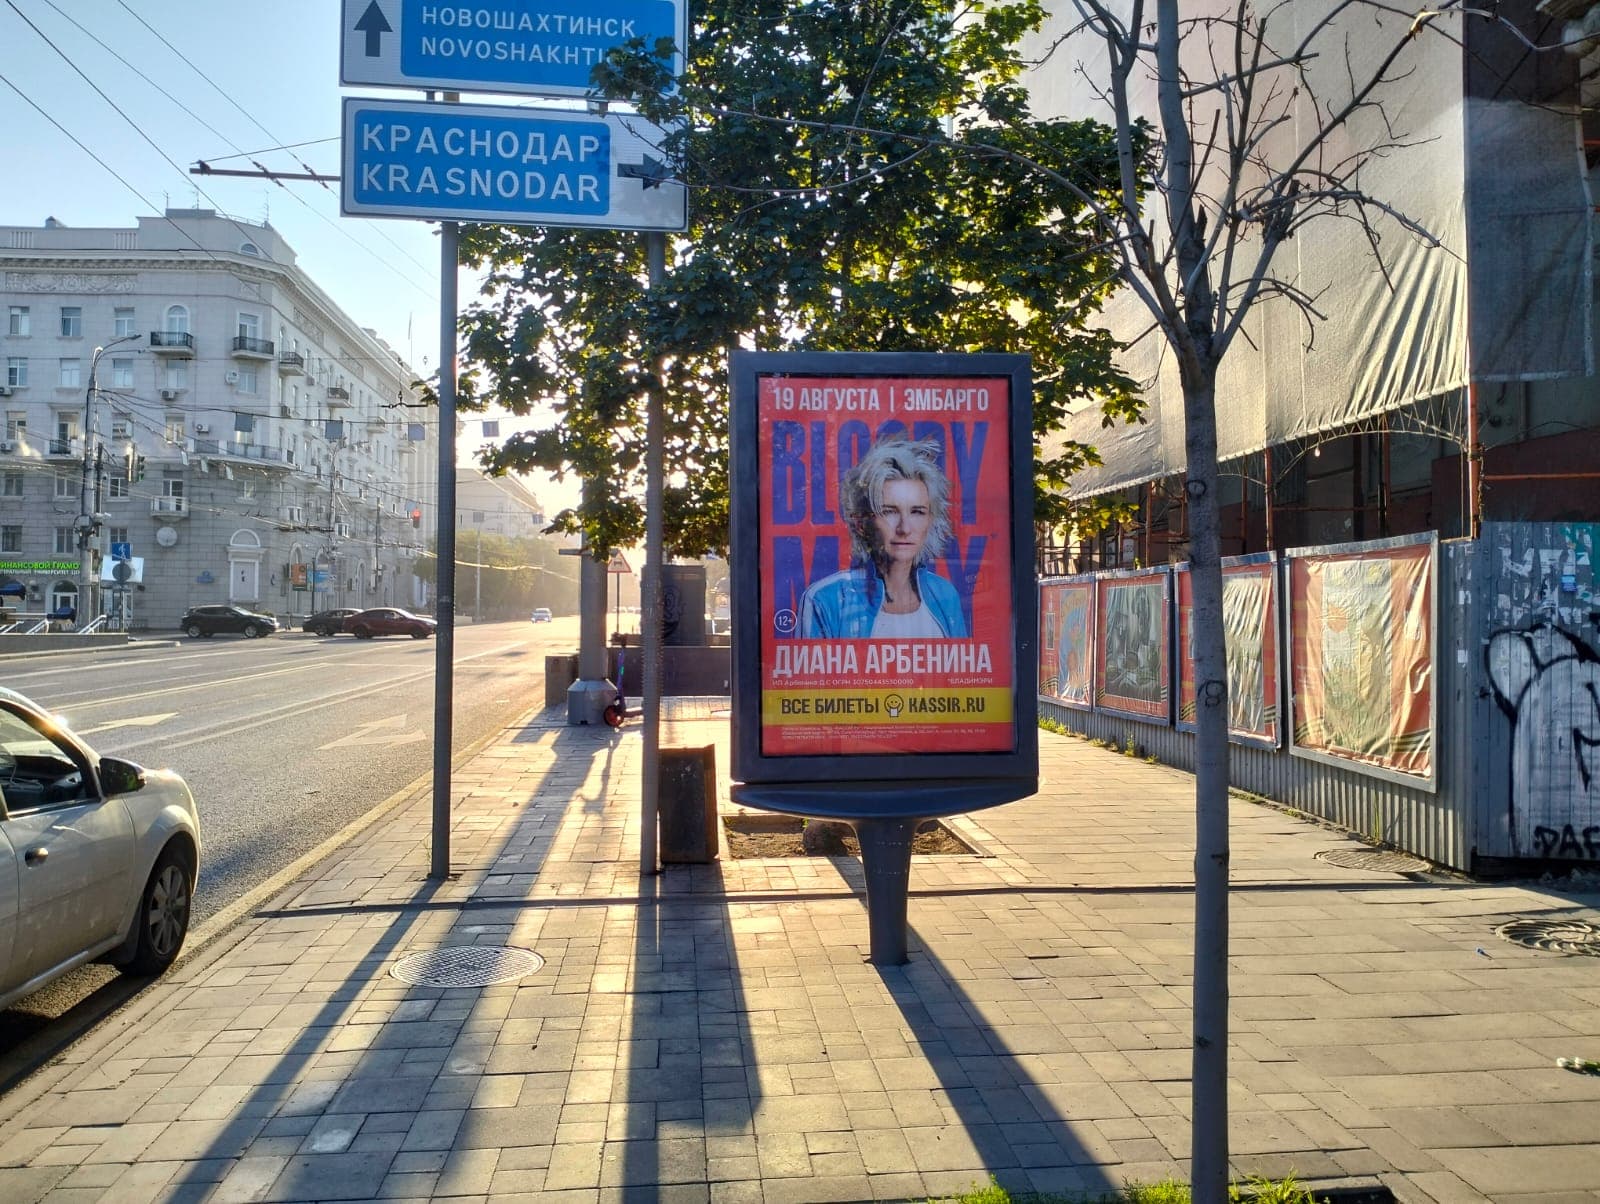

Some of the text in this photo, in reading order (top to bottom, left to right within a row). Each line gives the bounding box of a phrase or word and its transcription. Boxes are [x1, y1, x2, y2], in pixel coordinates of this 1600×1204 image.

[422, 6, 636, 38] НОВОШАХТИНСК
[422, 37, 625, 67] NOVOSHAKHTI
[362, 123, 600, 165] КРАСНОДАР
[361, 163, 600, 202] KRASNODAR
[773, 387, 794, 411] 19
[798, 388, 880, 411] АВГУСТА
[904, 387, 990, 411] ЭМБАРГО
[0, 561, 80, 569] ИНАНСОВОЙ ГРАМО
[777, 615, 793, 627] 12+
[772, 643, 993, 679] ДИАНА АРБЕНИНА
[782, 697, 879, 714] ВСЕ БИЛЕТЫ
[909, 696, 985, 713] KASSIR.RU
